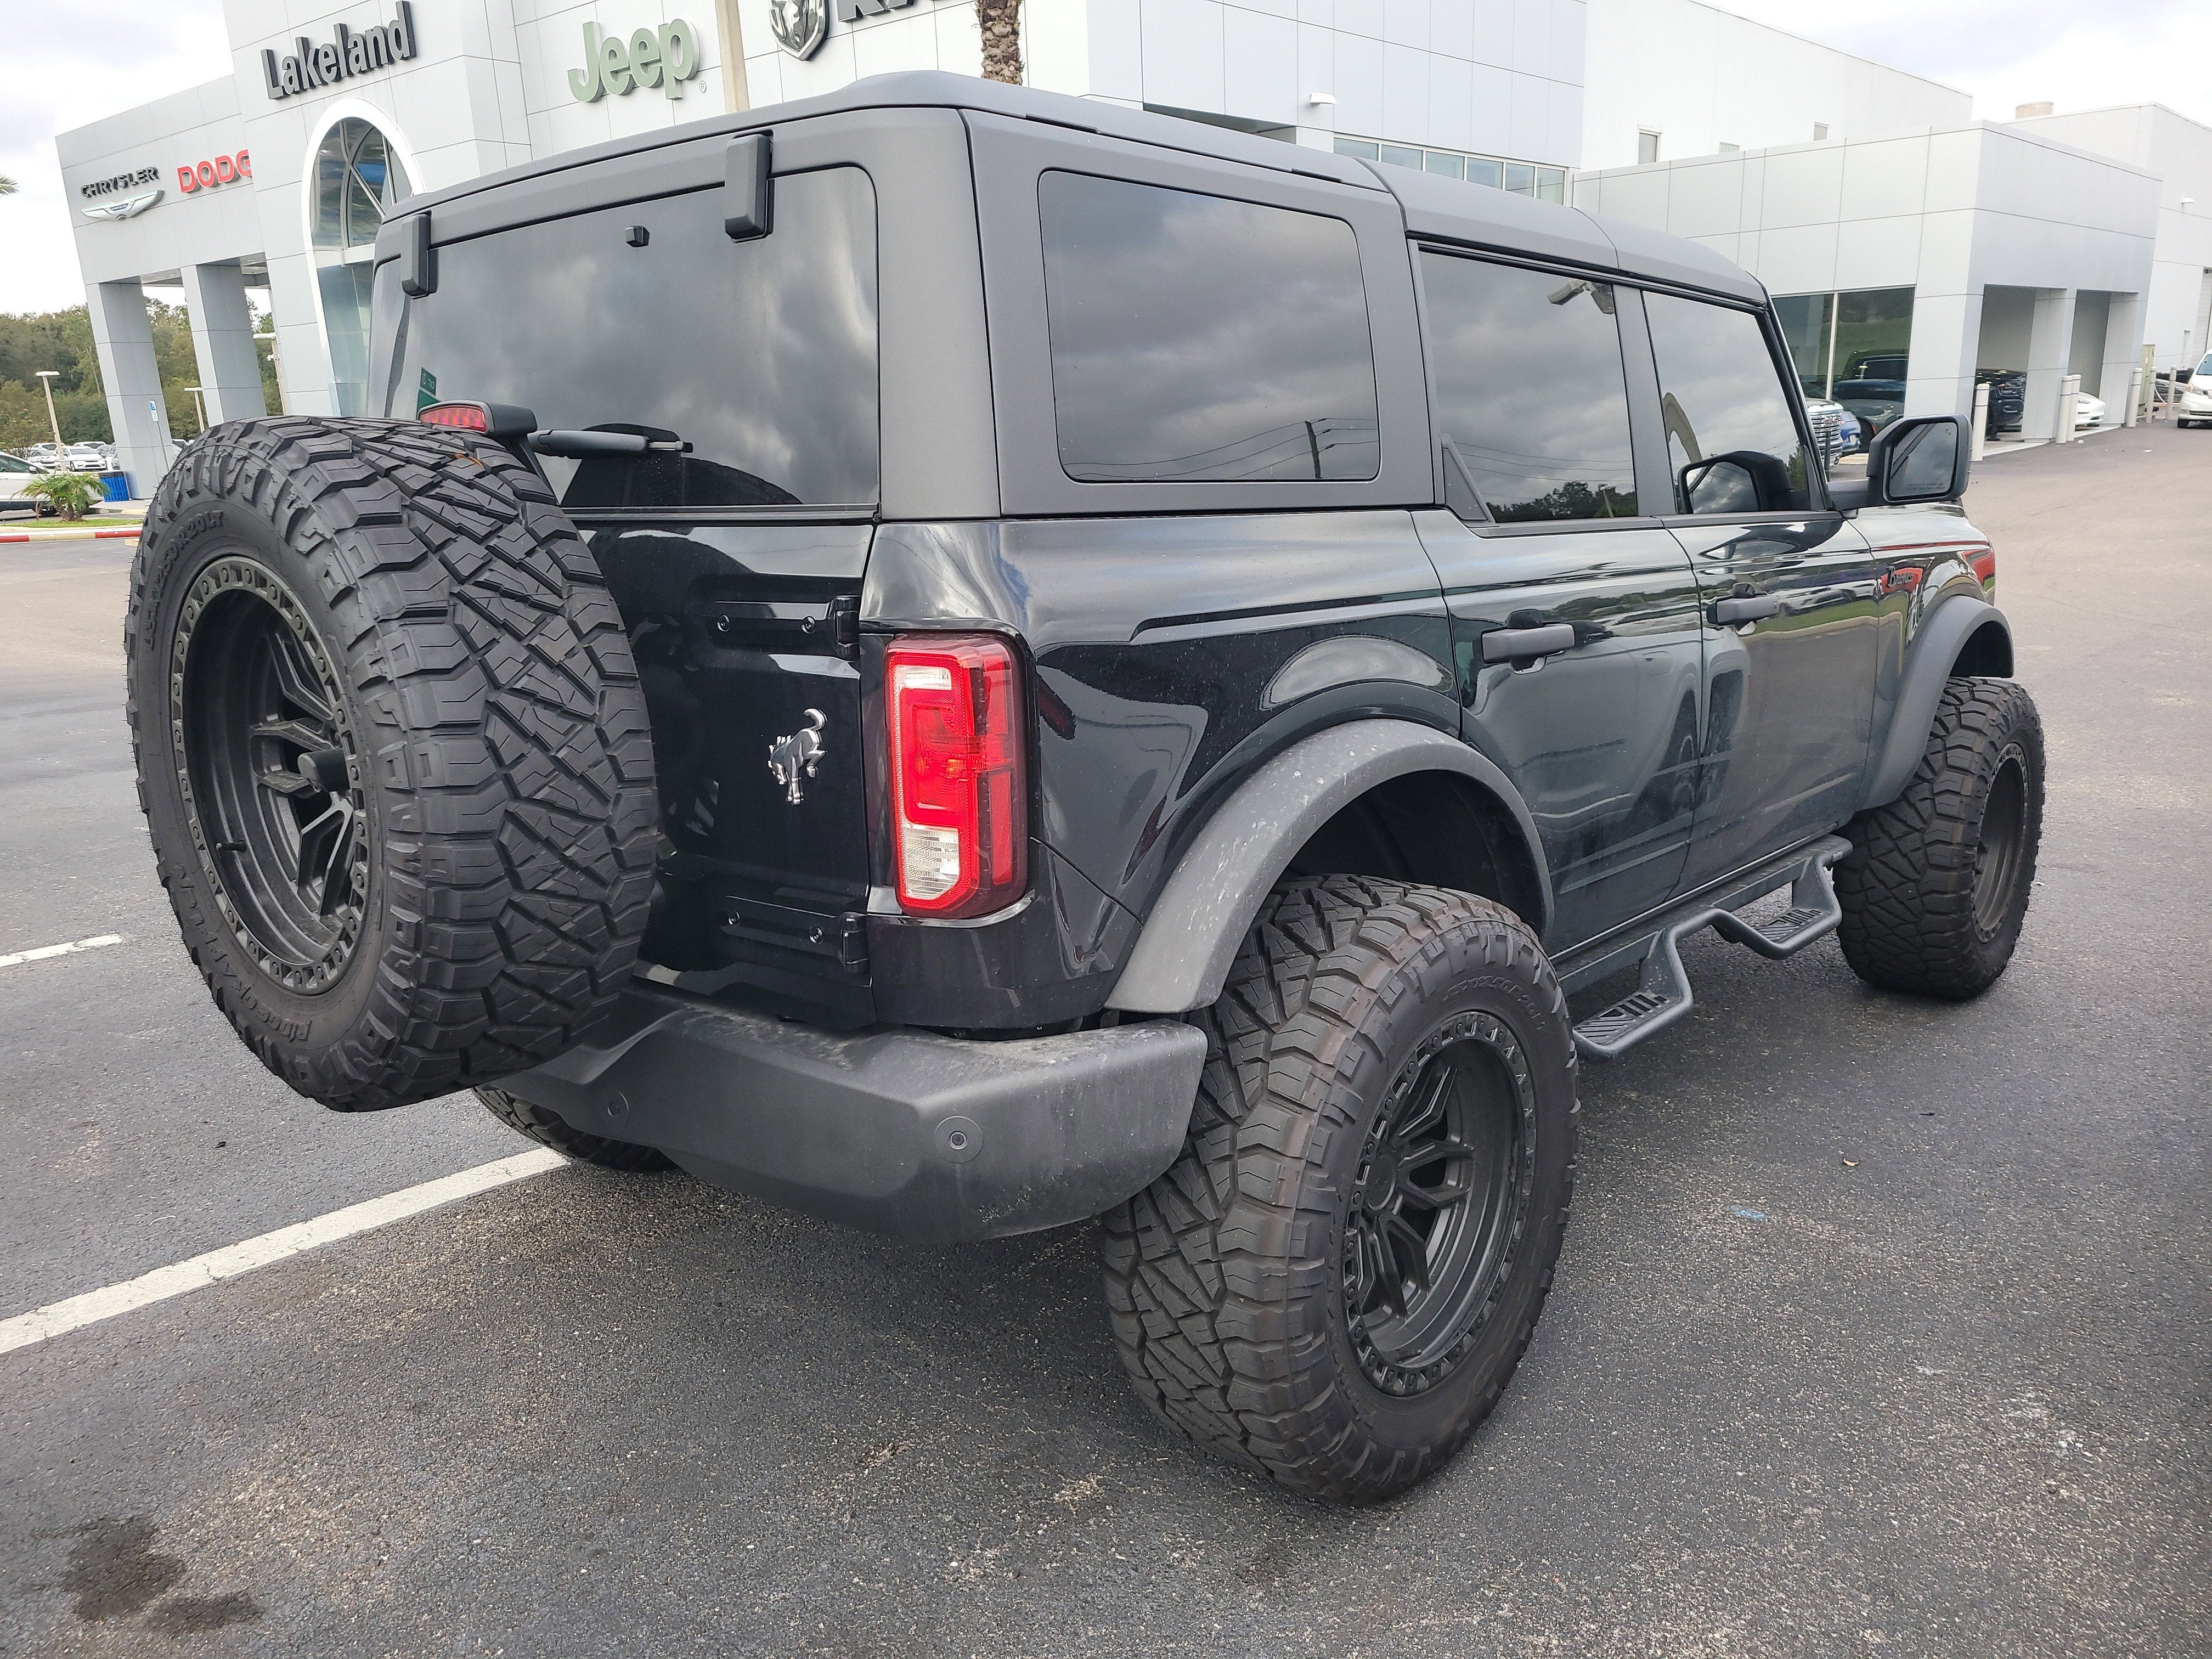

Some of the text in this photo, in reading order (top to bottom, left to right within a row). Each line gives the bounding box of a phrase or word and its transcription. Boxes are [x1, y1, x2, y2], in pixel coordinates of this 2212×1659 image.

[261, 1, 417, 100] Lakeland
[567, 18, 701, 103] Jeep
[81, 166, 159, 198] CHRYSLER
